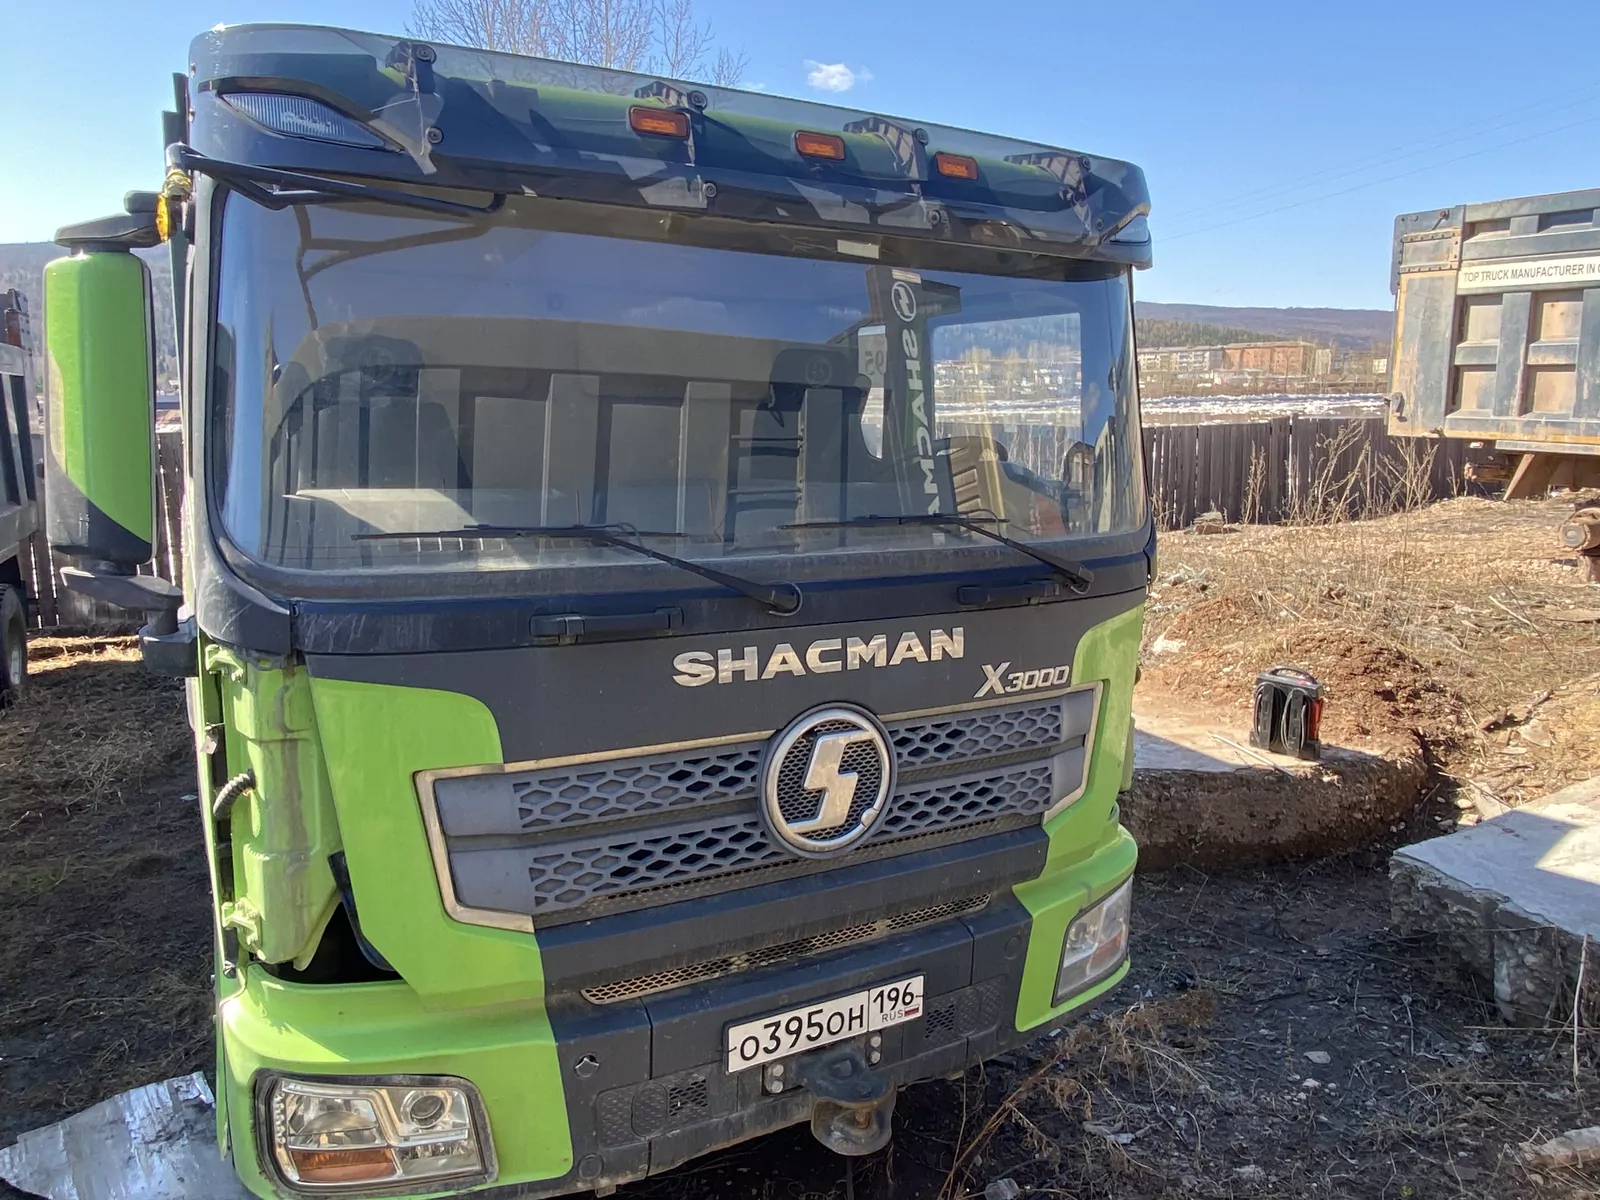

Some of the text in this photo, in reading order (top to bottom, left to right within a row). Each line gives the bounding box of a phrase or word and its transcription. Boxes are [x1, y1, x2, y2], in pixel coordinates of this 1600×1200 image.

[1463, 272, 1480, 283] TOP
[1481, 269, 1509, 282] TRUCK
[1510, 264, 1584, 279] MANUFACTURER
[1586, 263, 1596, 274] IN
[672, 626, 964, 687] SHACMAN
[973, 662, 1070, 698] X3000
[873, 982, 914, 1014] 196
[881, 1009, 904, 1023] RUS
